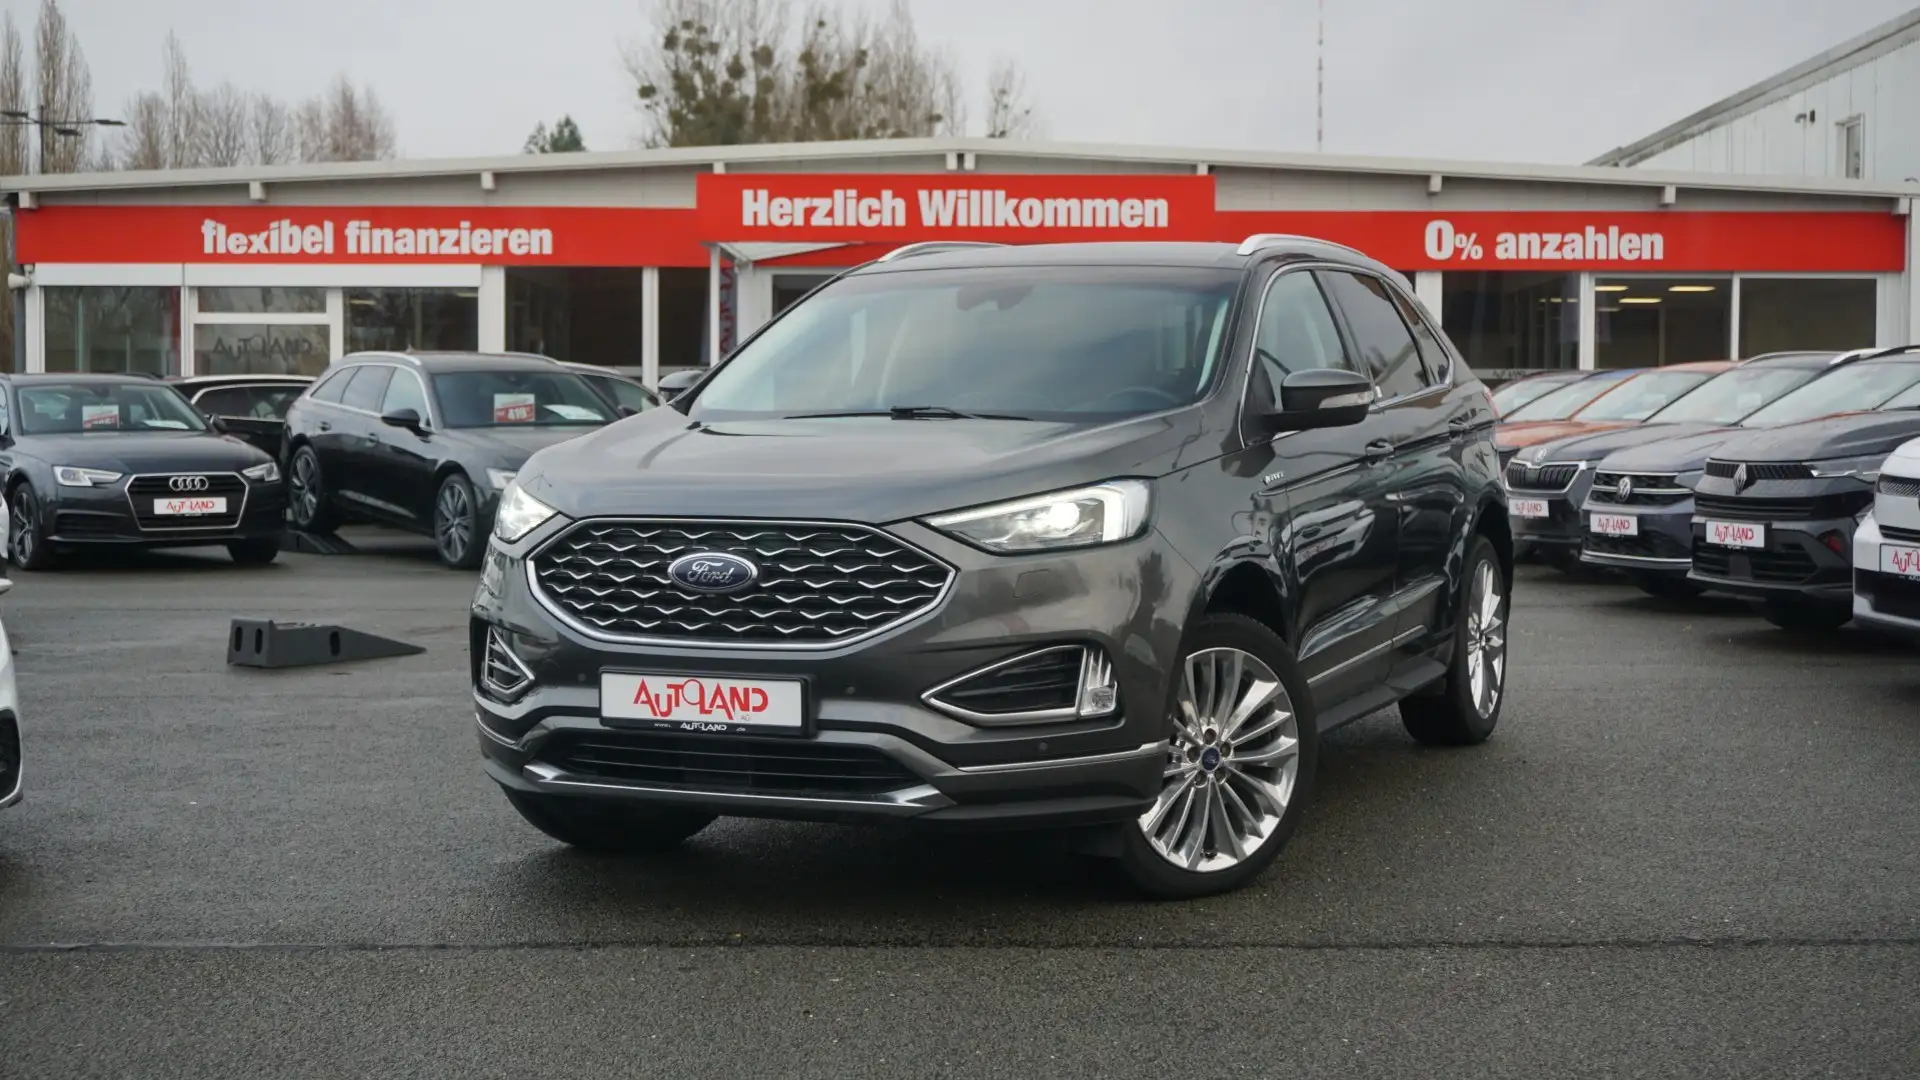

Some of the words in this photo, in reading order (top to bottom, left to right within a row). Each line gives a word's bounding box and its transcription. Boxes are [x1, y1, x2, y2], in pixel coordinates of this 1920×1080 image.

[742, 188, 906, 228] Herzlich
[918, 189, 1169, 228] Willkommen
[201, 218, 334, 255] flexibel
[345, 220, 553, 255] finanzieren
[1424, 219, 1484, 261] 0%
[1495, 225, 1664, 261] anzahlen
[686, 560, 735, 584] Ford
[633, 678, 769, 721] AUTOLAND
